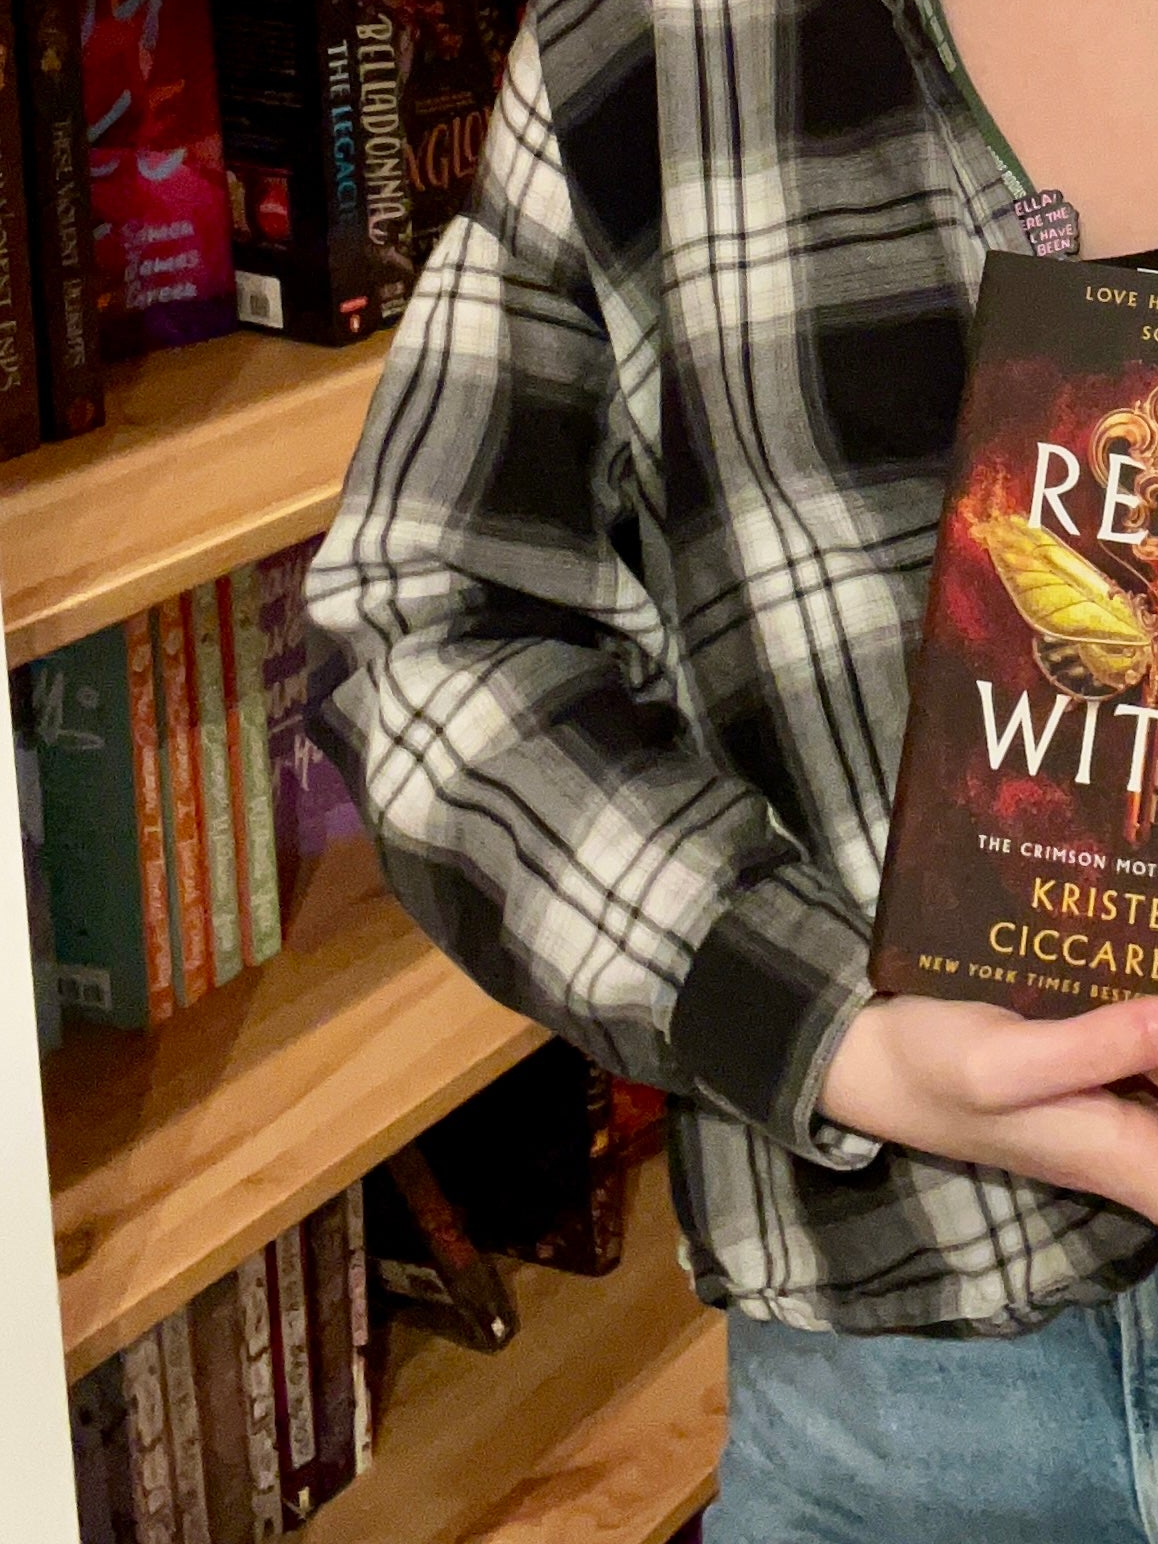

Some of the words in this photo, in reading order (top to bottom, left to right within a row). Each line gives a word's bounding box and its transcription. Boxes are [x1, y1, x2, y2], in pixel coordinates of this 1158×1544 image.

[327, 39, 352, 99] THE
[354, 12, 405, 246] BELLADONNA
[1045, 207, 1069, 223] THE
[1040, 224, 1074, 242] HAVE
[1037, 238, 1071, 257] BEEN
[1085, 287, 1138, 308] LOVE
[977, 834, 1010, 853] THE
[1020, 840, 1107, 870] CRIMSON
[919, 954, 960, 974] NEW
[968, 963, 1016, 984] YORK
[1027, 973, 1081, 995] TIMES
[1089, 983, 1142, 1003] BEST
